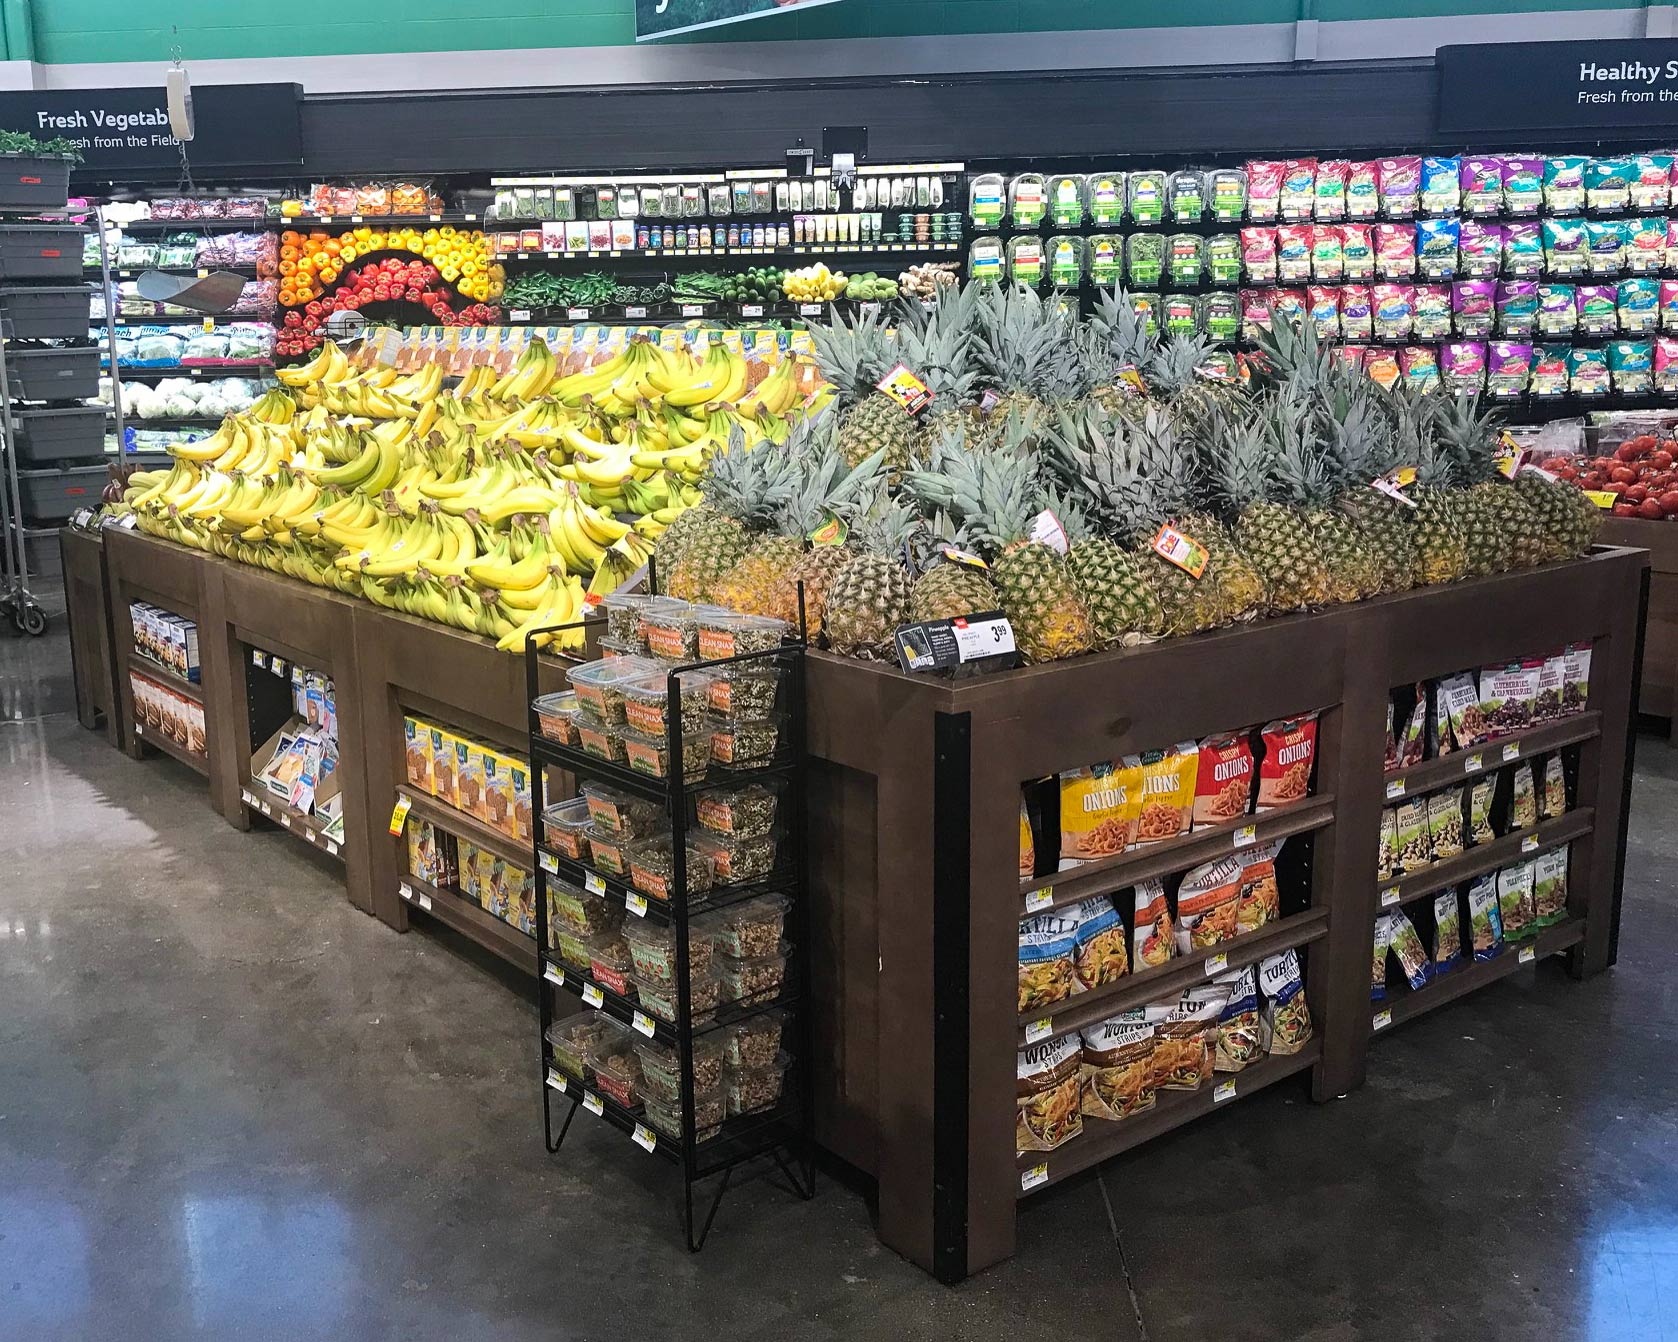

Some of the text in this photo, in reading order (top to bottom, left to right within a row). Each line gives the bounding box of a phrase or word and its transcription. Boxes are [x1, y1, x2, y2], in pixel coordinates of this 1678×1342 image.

[1580, 60, 1678, 84] Healthy S
[1578, 89, 1678, 104] Fresh from the
[37, 107, 170, 131] Fresh Vegetab
[94, 136, 125, 148] from
[127, 135, 147, 147] the
[1160, 533, 1177, 553] Dole
[649, 633, 683, 647] CLEAN SNAX
[699, 636, 735, 650] CLEAN SNAX
[626, 706, 663, 723] CLEAN SNAX
[1285, 730, 1305, 746] CRISPY
[1218, 746, 1241, 761] CRISPY
[1278, 739, 1311, 766] ONIONS
[1214, 755, 1249, 782] ONIONS
[1083, 785, 1128, 813] ONIONS
[1116, 1031, 1142, 1045] STRIPS
